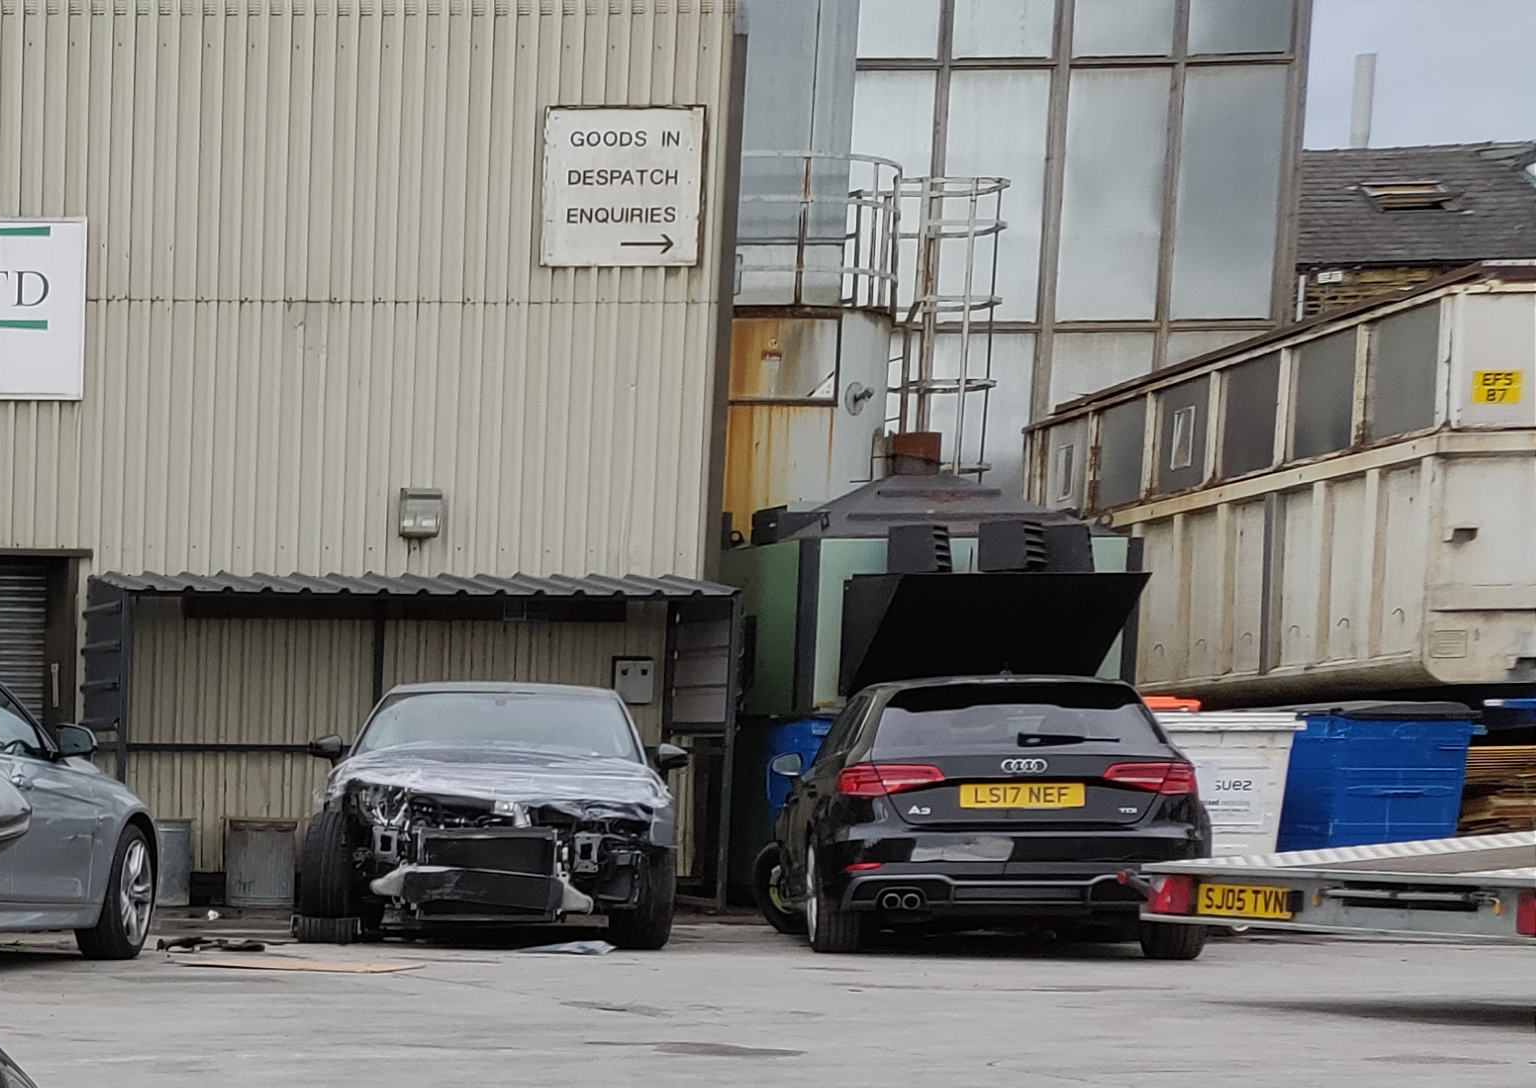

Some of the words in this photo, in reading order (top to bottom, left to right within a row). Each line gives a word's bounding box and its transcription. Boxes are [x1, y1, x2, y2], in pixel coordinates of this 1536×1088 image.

[570, 130, 647, 147] GOODS
[661, 130, 680, 147] IN
[567, 168, 678, 186] DESPATCH
[566, 206, 676, 224] ENQUIRIES
[1486, 388, 1508, 403] 87
[974, 787, 1022, 804] LS17
[1028, 787, 1071, 804] NEF
[908, 805, 932, 816] A3
[1204, 888, 1247, 911] SJ05
